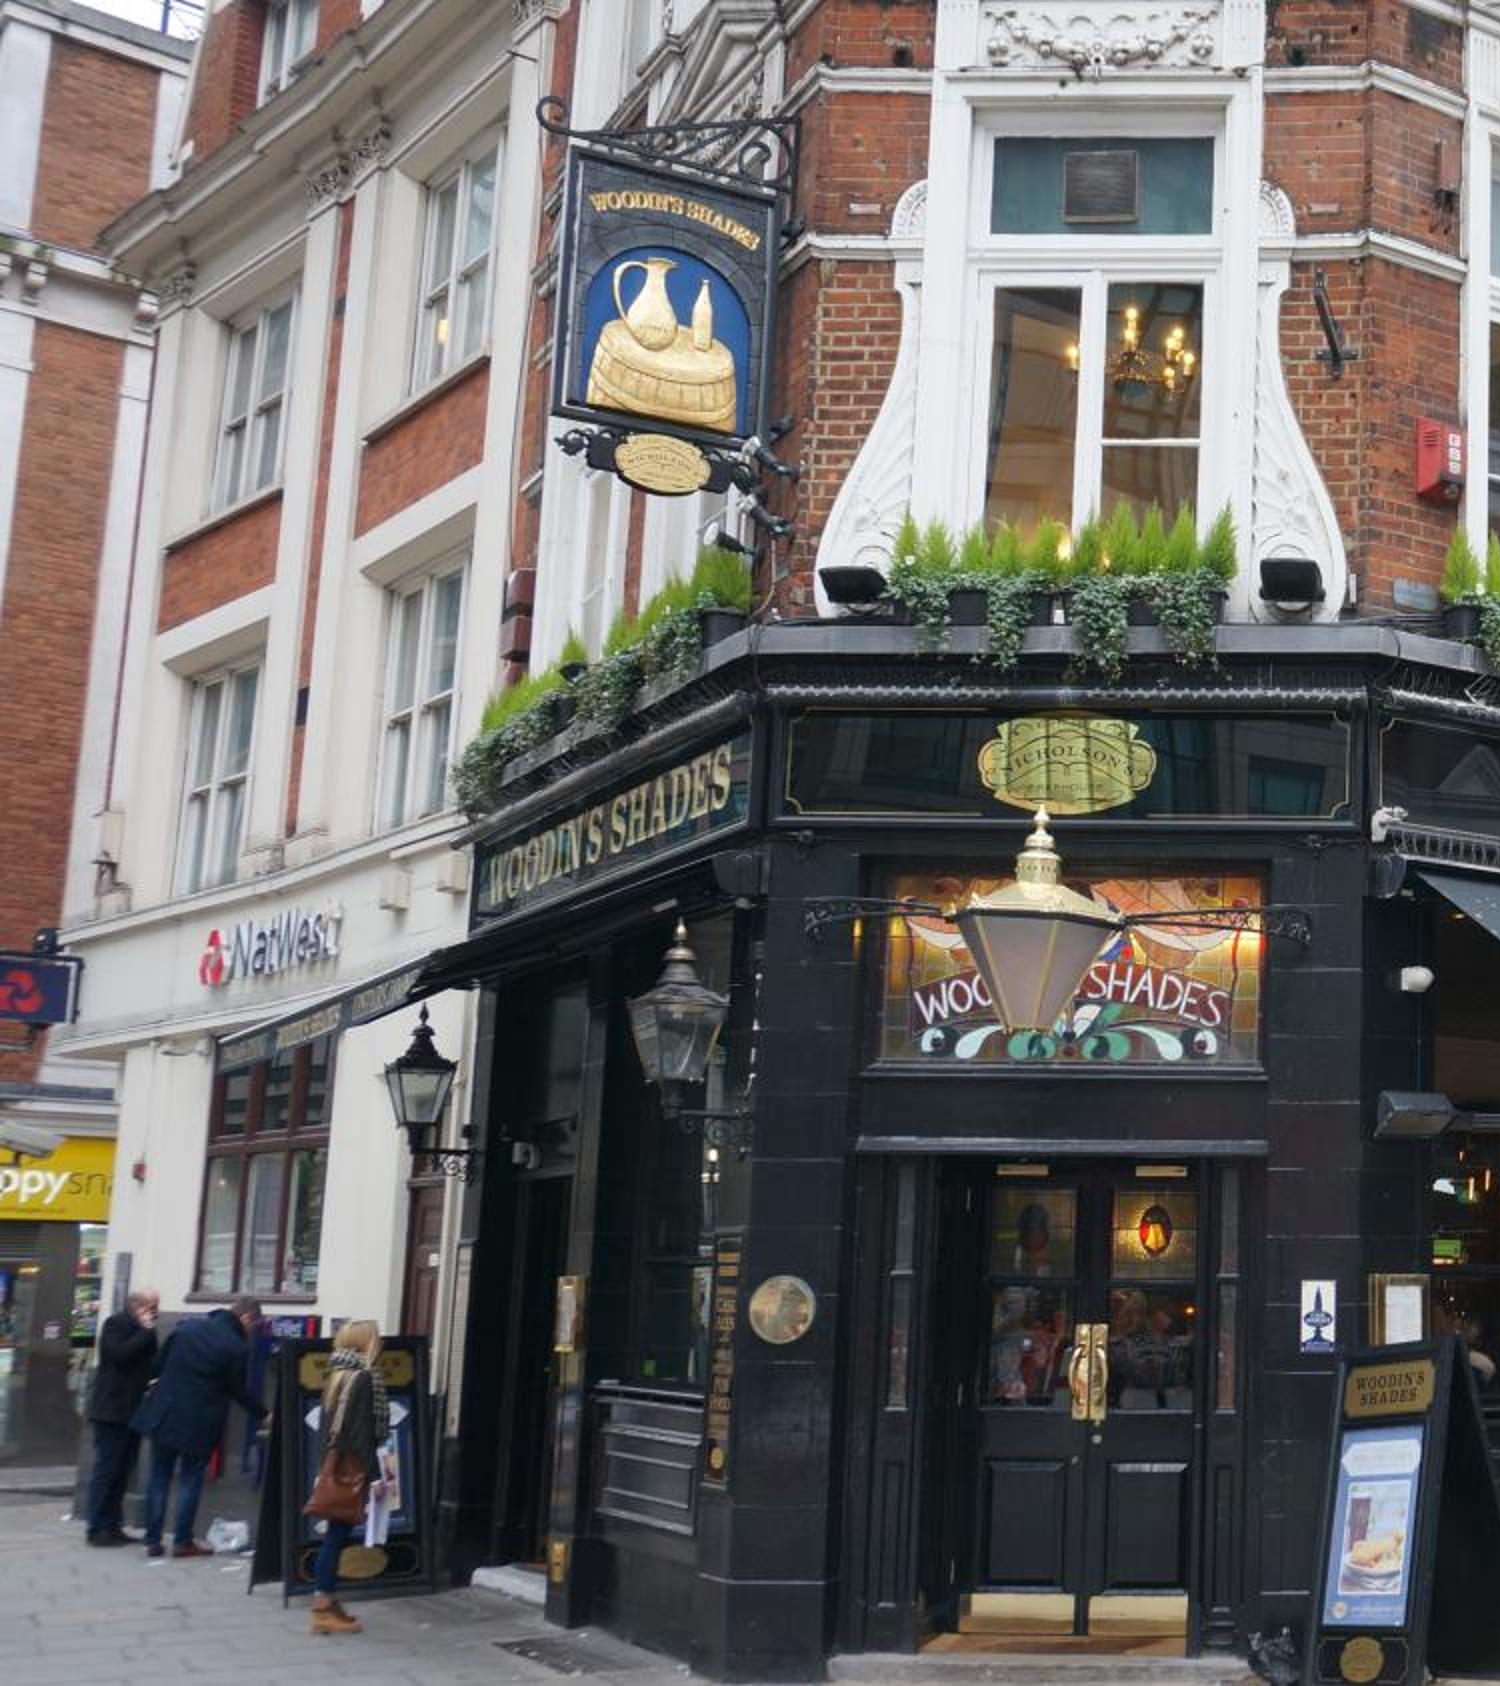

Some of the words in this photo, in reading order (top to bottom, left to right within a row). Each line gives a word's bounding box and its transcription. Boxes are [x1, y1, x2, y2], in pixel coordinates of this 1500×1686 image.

[589, 190, 684, 215] WOODIN'S
[686, 202, 761, 251] SHADES
[489, 804, 602, 906] WOODIN'S
[609, 740, 733, 854] SHADES
[227, 905, 343, 983] NatWest
[1086, 962, 1230, 1027] SHADES
[1355, 1370, 1426, 1391] WOODIN'S
[1359, 1387, 1418, 1407] SHADES
